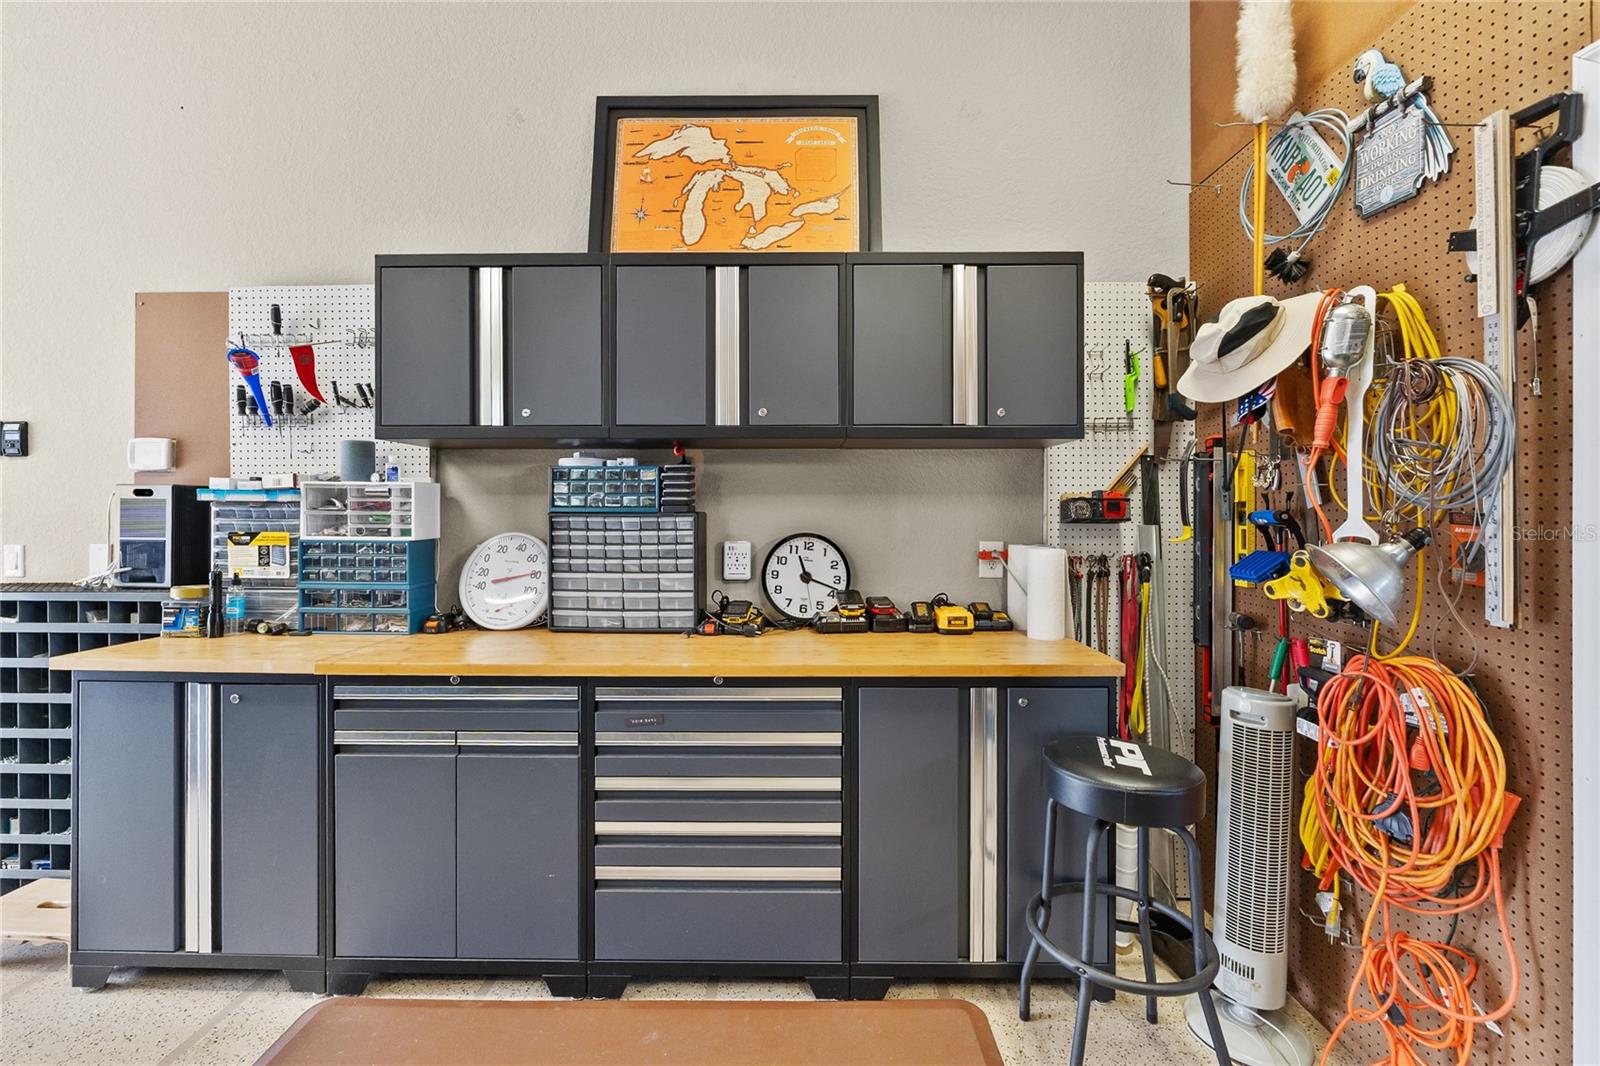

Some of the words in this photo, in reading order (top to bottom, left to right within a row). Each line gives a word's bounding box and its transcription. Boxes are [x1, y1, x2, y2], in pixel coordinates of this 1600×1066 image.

[1360, 127, 1417, 167] WORKING
[1370, 148, 1406, 171] DURING
[1360, 153, 1417, 190] DRINKING
[497, 545, 508, 554] 20
[515, 543, 527, 552] 40
[789, 545, 798, 554] 11
[803, 541, 814, 551] 12
[823, 548, 827, 557] 1
[484, 554, 490, 562] 0
[526, 554, 538, 563] 60
[776, 556, 787, 565] 10
[830, 560, 839, 569] 2
[530, 570, 542, 579] 80
[771, 570, 779, 579] 9
[833, 575, 841, 584] 3
[774, 585, 783, 594] 8
[827, 589, 835, 599] 4
[785, 598, 792, 607] 7
[816, 601, 824, 610] 5
[799, 604, 808, 613] 6
[1109, 739, 1153, 776] PT
